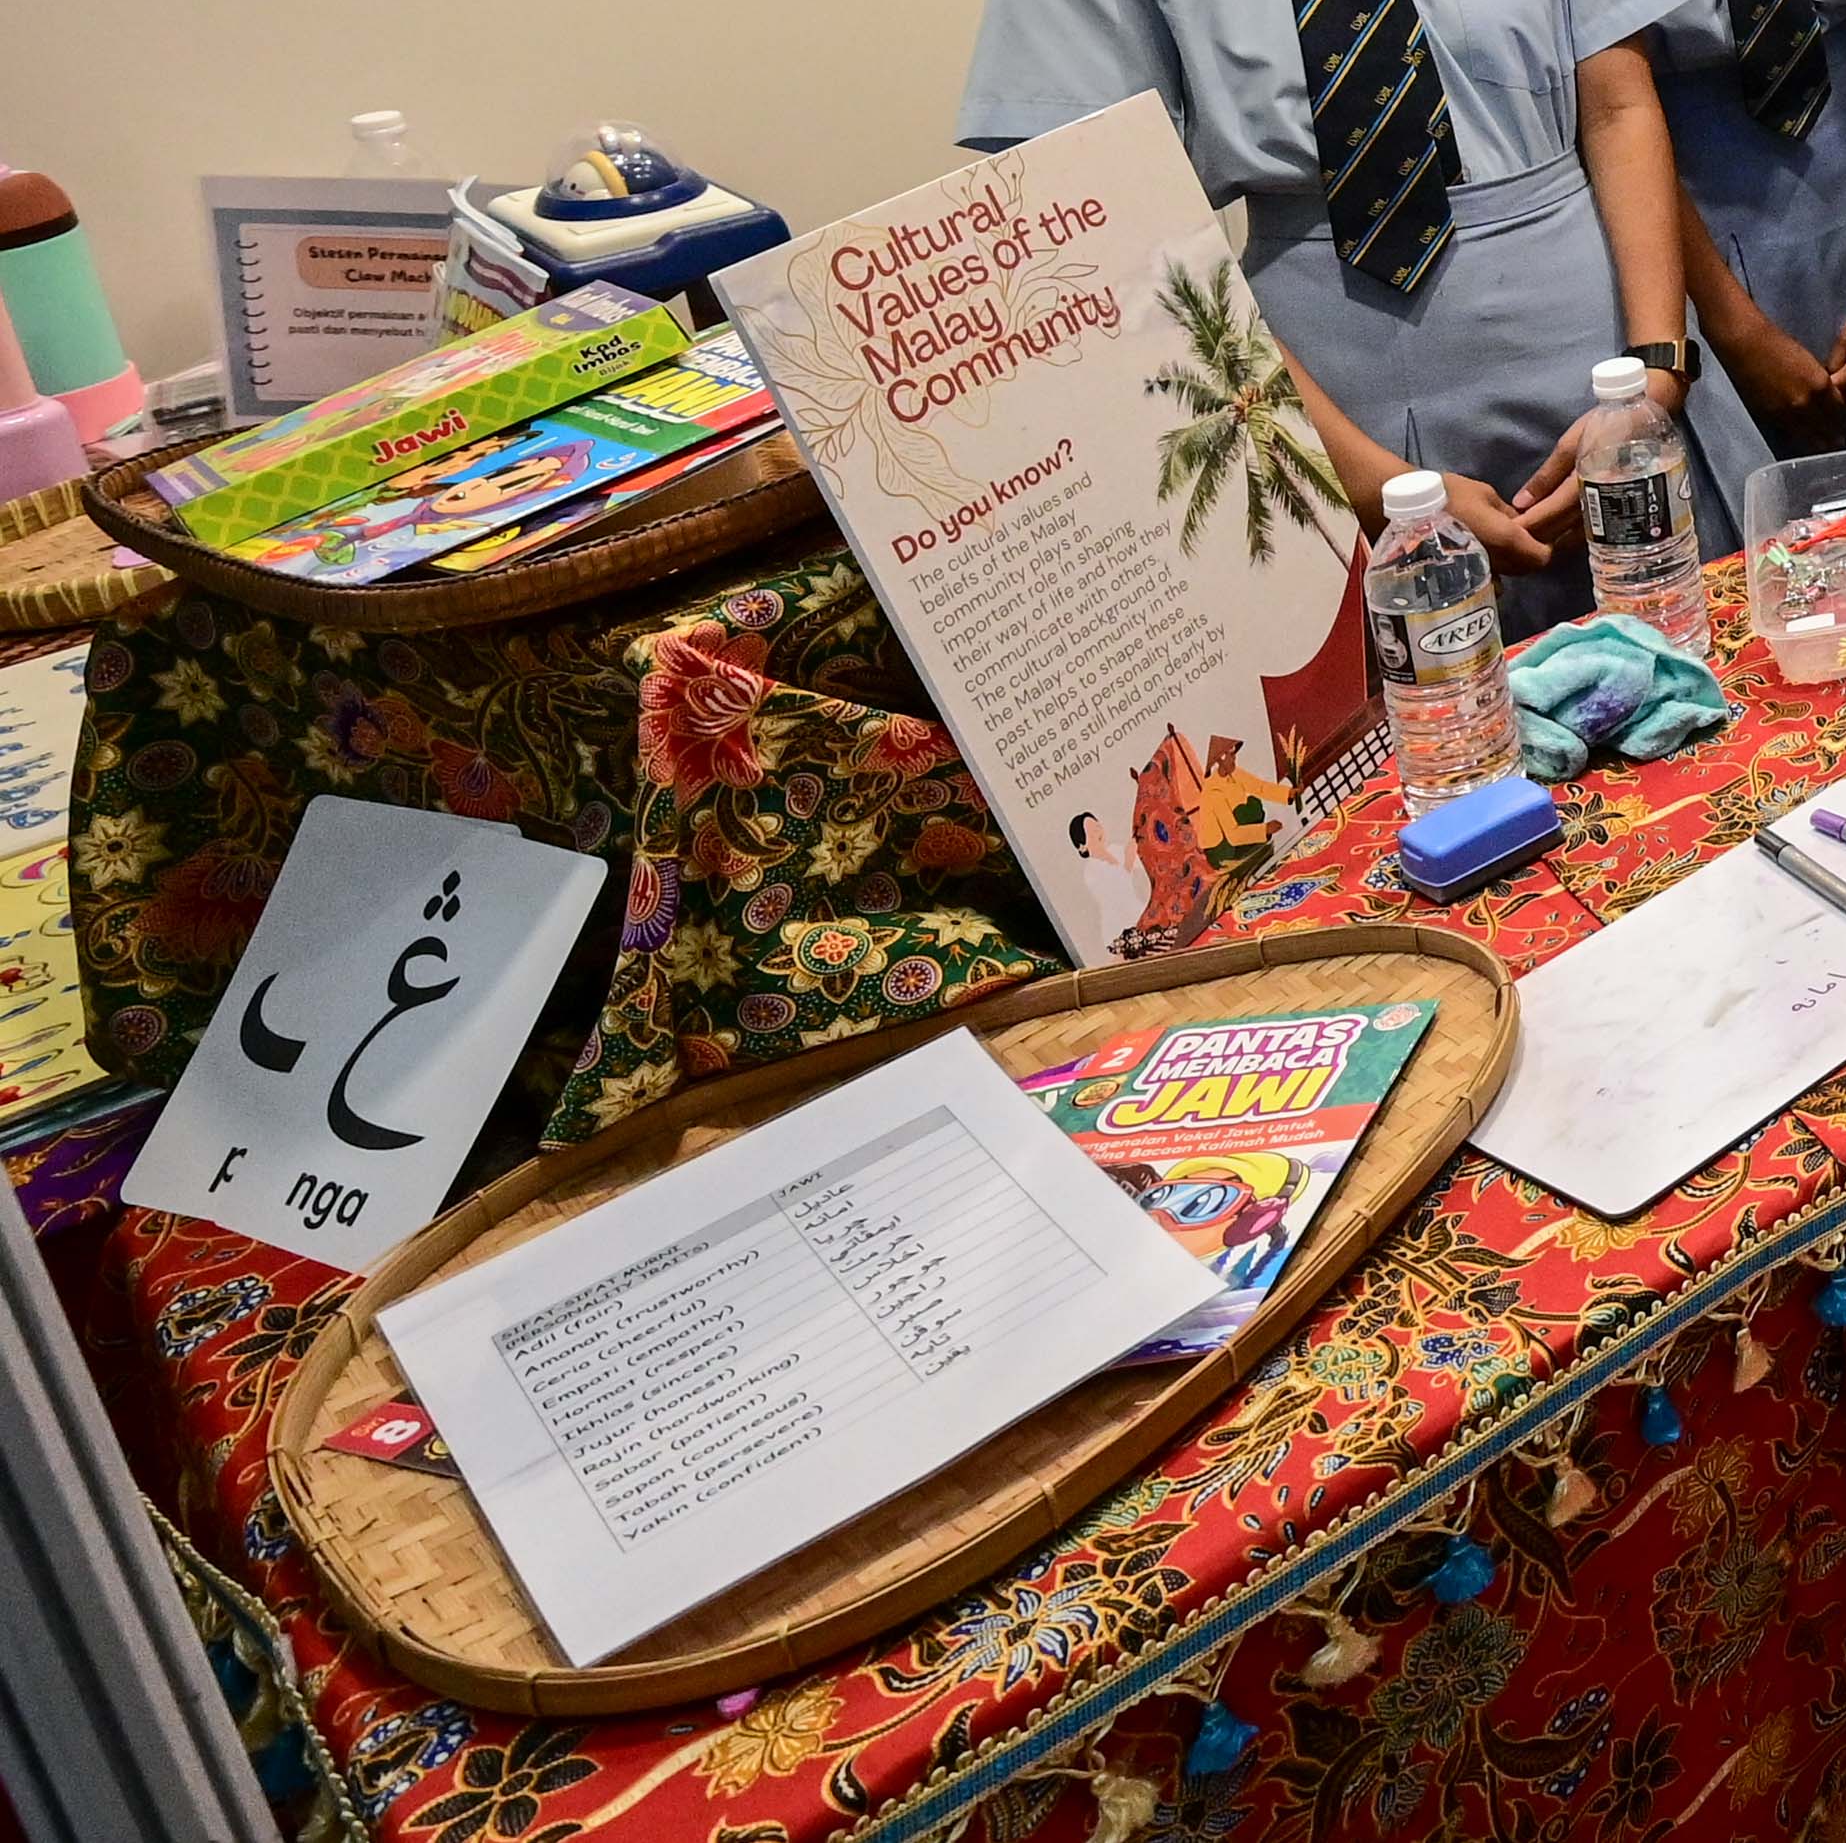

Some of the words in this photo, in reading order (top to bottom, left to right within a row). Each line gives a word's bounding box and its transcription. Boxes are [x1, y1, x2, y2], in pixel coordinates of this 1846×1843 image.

[309, 246, 363, 261] Stesen
[831, 184, 1006, 291] Cultural
[836, 254, 989, 339] Values
[993, 218, 1032, 270] of
[1039, 198, 1107, 246] the
[293, 308, 344, 322] Objektif
[860, 298, 1003, 386] Malay
[573, 340, 643, 375] Imbas
[580, 335, 623, 359] Kad
[887, 286, 1121, 423] Community
[373, 409, 471, 465] Jawi
[891, 529, 937, 565] Do
[940, 495, 993, 544] you
[990, 438, 1074, 505] know?
[907, 567, 945, 594] The
[947, 521, 1011, 572] cultural
[1010, 494, 1062, 533] values
[1063, 470, 1093, 501] and
[919, 571, 980, 616] beliefs
[981, 552, 1000, 580] of
[1000, 539, 1031, 564] the
[1029, 507, 1077, 552] Malay
[932, 565, 1027, 635] community
[1028, 538, 1072, 578] plays
[1072, 524, 1093, 544] an
[939, 590, 1027, 655] important
[1022, 571, 1059, 600] role
[1057, 559, 1077, 577] in
[1076, 519, 1137, 566] shaping
[1101, 1047, 1132, 1069] 2
[1149, 1048, 1337, 1082] MEMBACA
[1164, 1022, 1353, 1062] PANTAS
[1111, 1067, 1333, 1126] JAWI
[1127, 1145, 1193, 1160] Bacaan
[1196, 1137, 1267, 1155] Kalimah
[1270, 1129, 1325, 1146] Mudah
[1173, 1129, 1220, 1143] Vokal
[1223, 1125, 1264, 1140] Jawi
[1267, 1119, 1317, 1134] Untuk
[285, 1170, 370, 1231] nga
[778, 1171, 824, 1199] JAWI
[500, 1275, 618, 1342] SIFAT-SIFAT
[622, 1244, 683, 1280] MURNI
[523, 1329, 610, 1379] Amanah
[615, 1249, 760, 1331] (trustworthy)
[513, 1332, 558, 1362] Adil
[563, 1300, 624, 1336] (fair)
[531, 1360, 592, 1394] Ceria
[597, 1298, 707, 1361] (cheerful)
